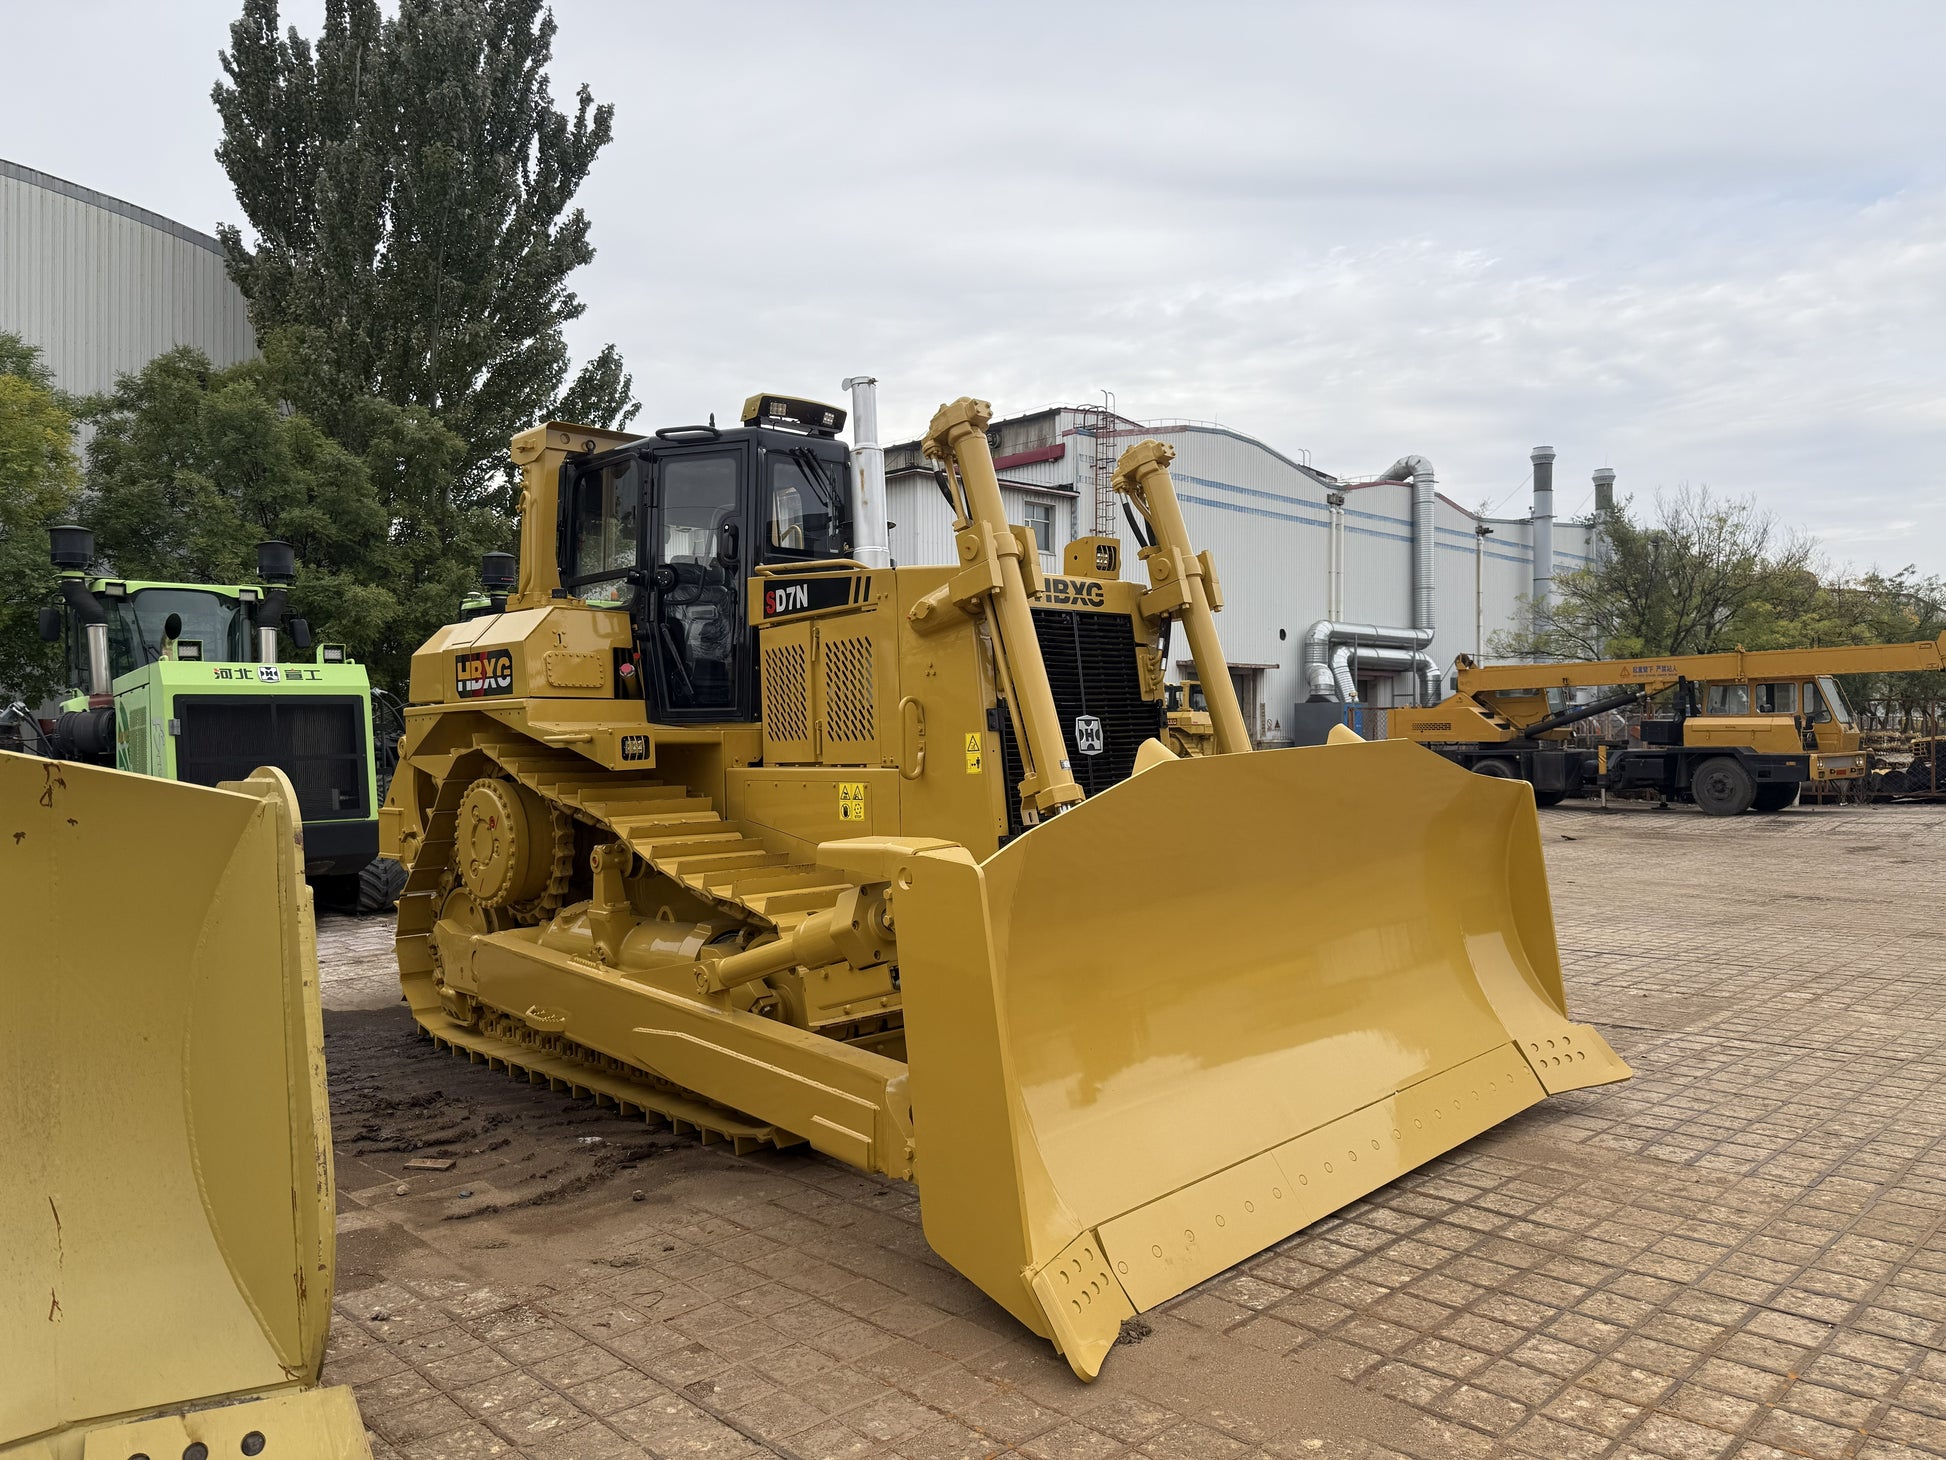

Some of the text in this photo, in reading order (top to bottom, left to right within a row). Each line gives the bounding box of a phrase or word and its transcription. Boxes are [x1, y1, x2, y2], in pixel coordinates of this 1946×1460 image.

[765, 583, 809, 615] SD7N
[213, 668, 254, 680] 河北
[284, 668, 323, 681] 宣工
[457, 656, 511, 692] HBXG
